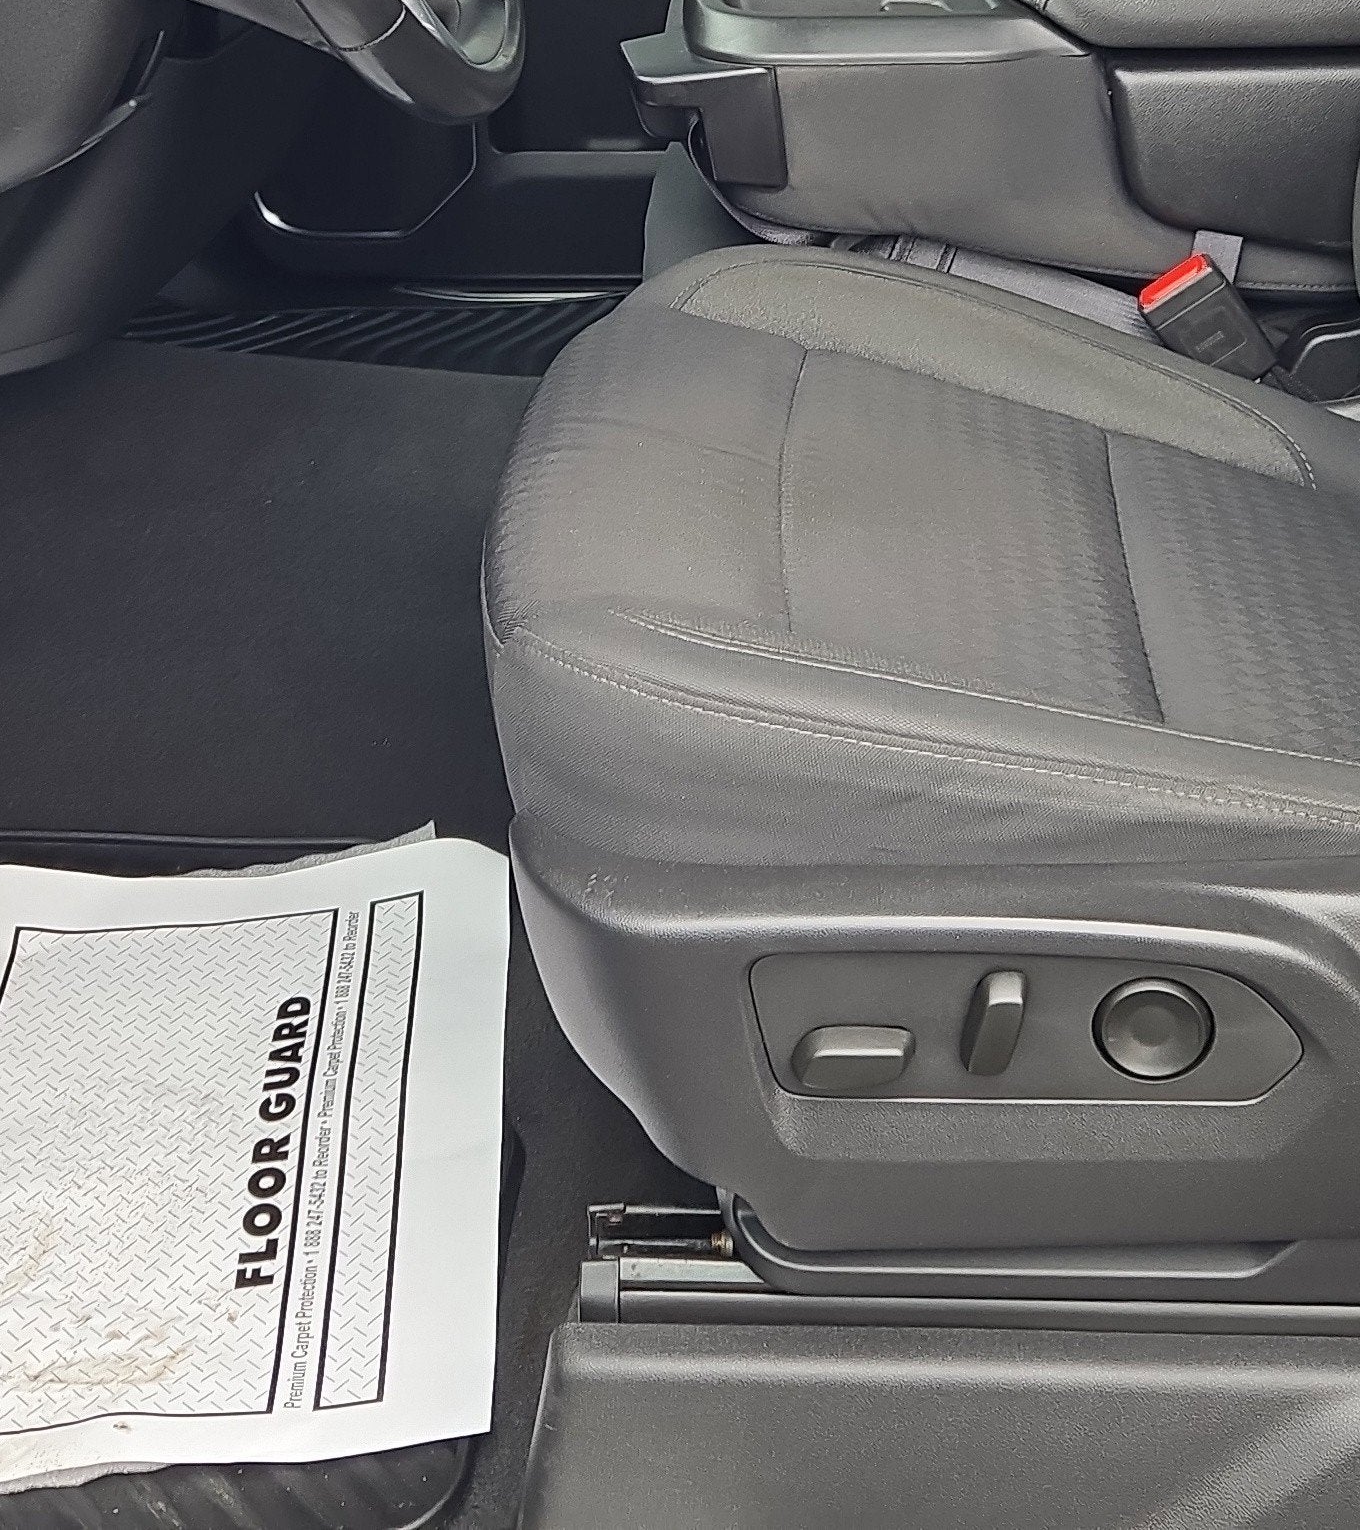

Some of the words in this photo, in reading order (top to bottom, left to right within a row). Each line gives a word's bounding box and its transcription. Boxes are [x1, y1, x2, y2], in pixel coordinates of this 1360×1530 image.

[343, 911, 360, 941] Reorder
[327, 1010, 348, 1049] Protection
[258, 995, 312, 1123] GUARD
[323, 1050, 343, 1078] Carpet
[317, 1077, 337, 1118] Premium
[313, 1125, 332, 1166] Reorder
[315, 1165, 327, 1176] to
[234, 1133, 292, 1290] FLOOR
[307, 1177, 328, 1228] 247-5432
[305, 1227, 321, 1248] 888
[295, 1265, 318, 1318] Protection
[291, 1320, 315, 1356] Carpet
[283, 1360, 307, 1409] Premium
